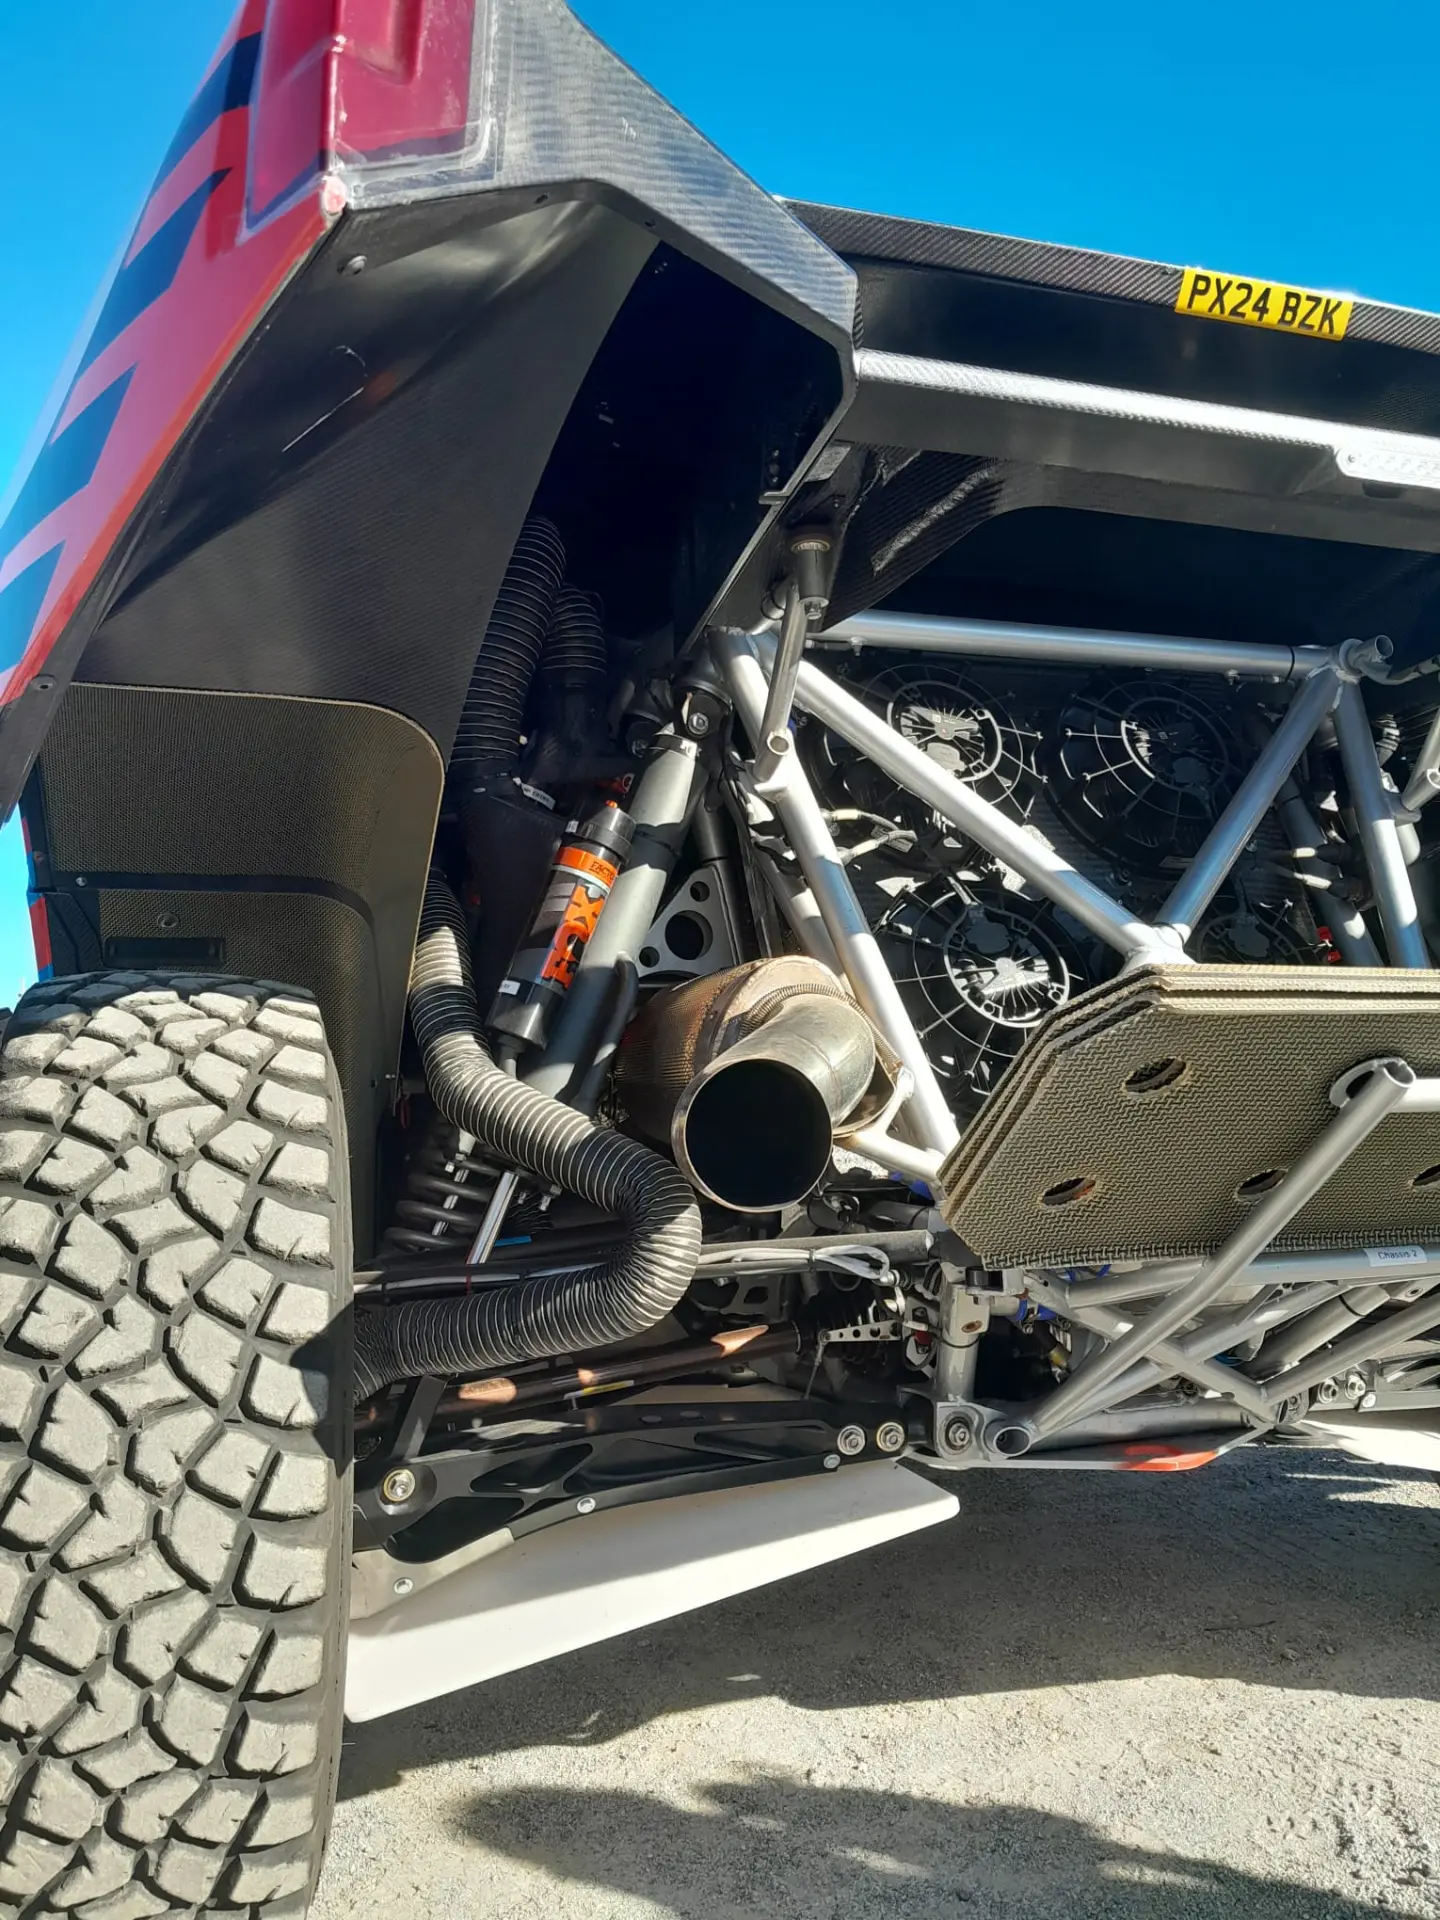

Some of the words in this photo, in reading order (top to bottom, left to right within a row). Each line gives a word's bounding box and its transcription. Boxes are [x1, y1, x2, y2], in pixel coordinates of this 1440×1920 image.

[1186, 273, 1271, 322] PX24
[1277, 290, 1343, 334] BZK
[1377, 1251, 1411, 1260] Chassis
[1411, 1249, 1418, 1257] 2
